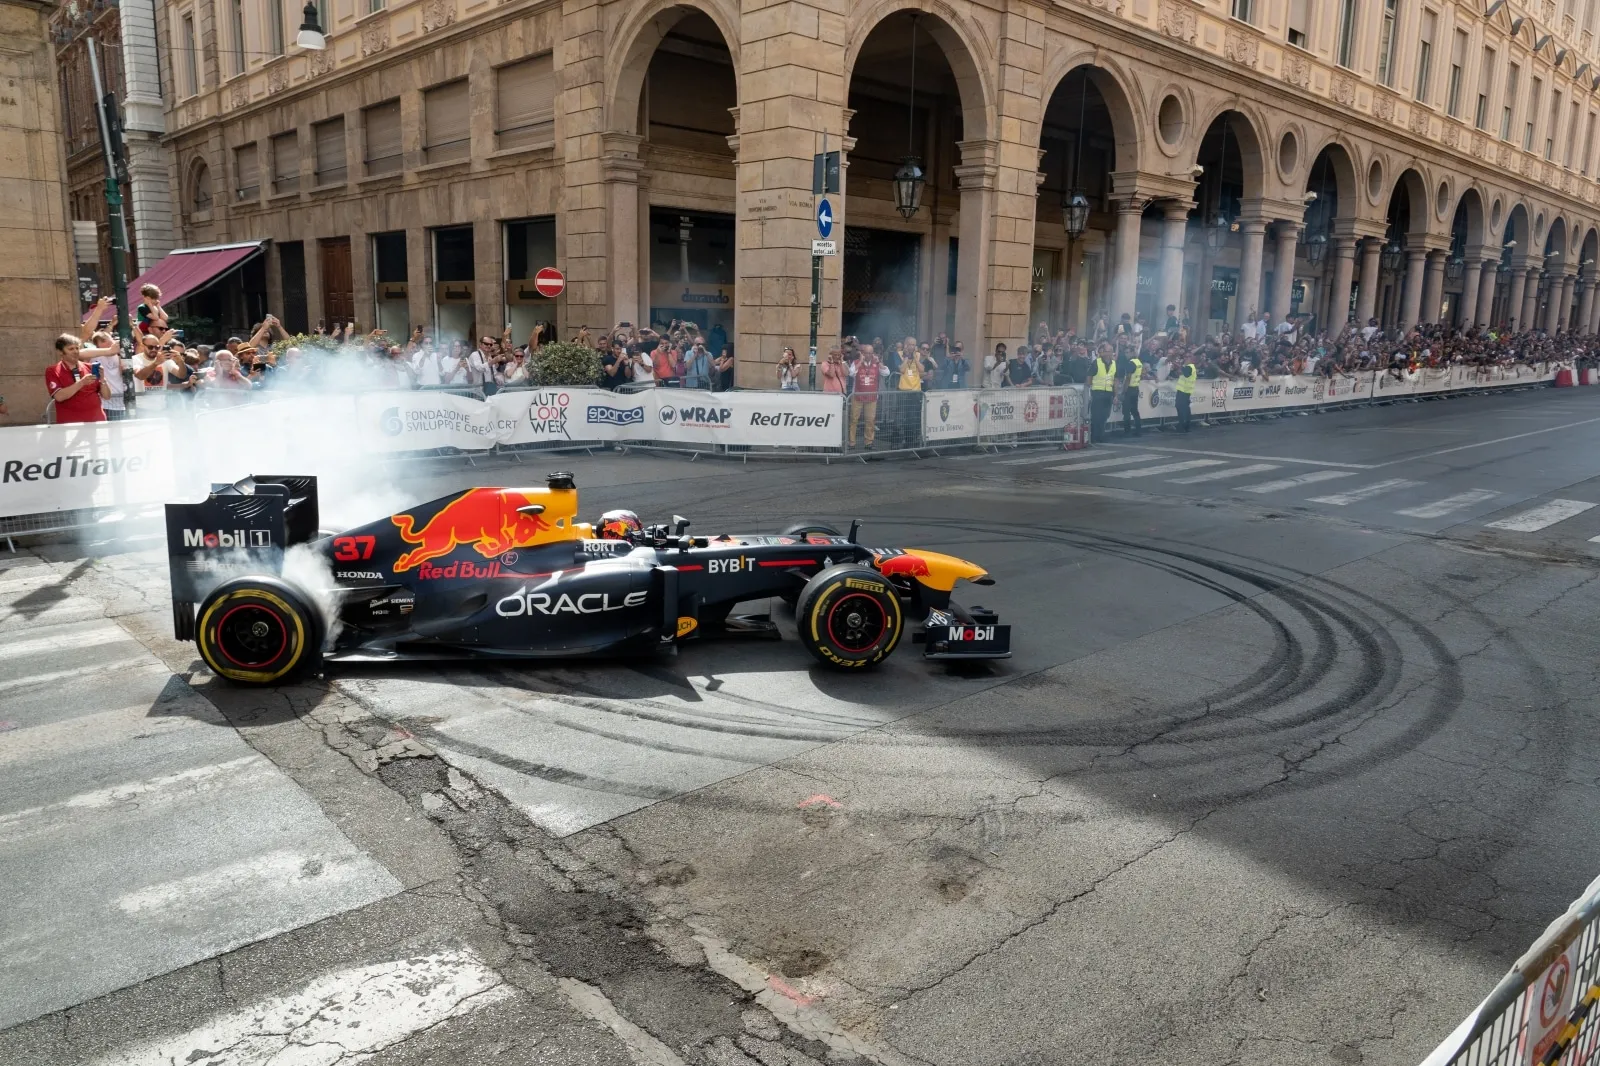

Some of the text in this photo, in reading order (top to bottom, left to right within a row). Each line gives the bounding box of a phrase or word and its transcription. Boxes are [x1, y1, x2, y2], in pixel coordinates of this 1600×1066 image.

[530, 393, 570, 407] AUTO
[406, 410, 470, 424] FONDAZIONE
[530, 406, 567, 420] LOOK
[588, 406, 643, 424] sparco
[680, 406, 732, 424] WRAP
[991, 404, 1014, 415] Torino
[498, 420, 518, 430] CRT
[532, 420, 571, 440] WEEK
[184, 529, 246, 548] Mobil
[584, 542, 616, 552] ROKT
[333, 536, 376, 562] 37
[418, 562, 502, 580] Red Bull
[708, 554, 756, 574] BYBIT
[336, 571, 384, 580] HONDA
[846, 578, 885, 594] PIRELLI
[496, 590, 648, 618] ORACLE
[948, 626, 994, 642] Mobil
[820, 646, 868, 667] ZERO
